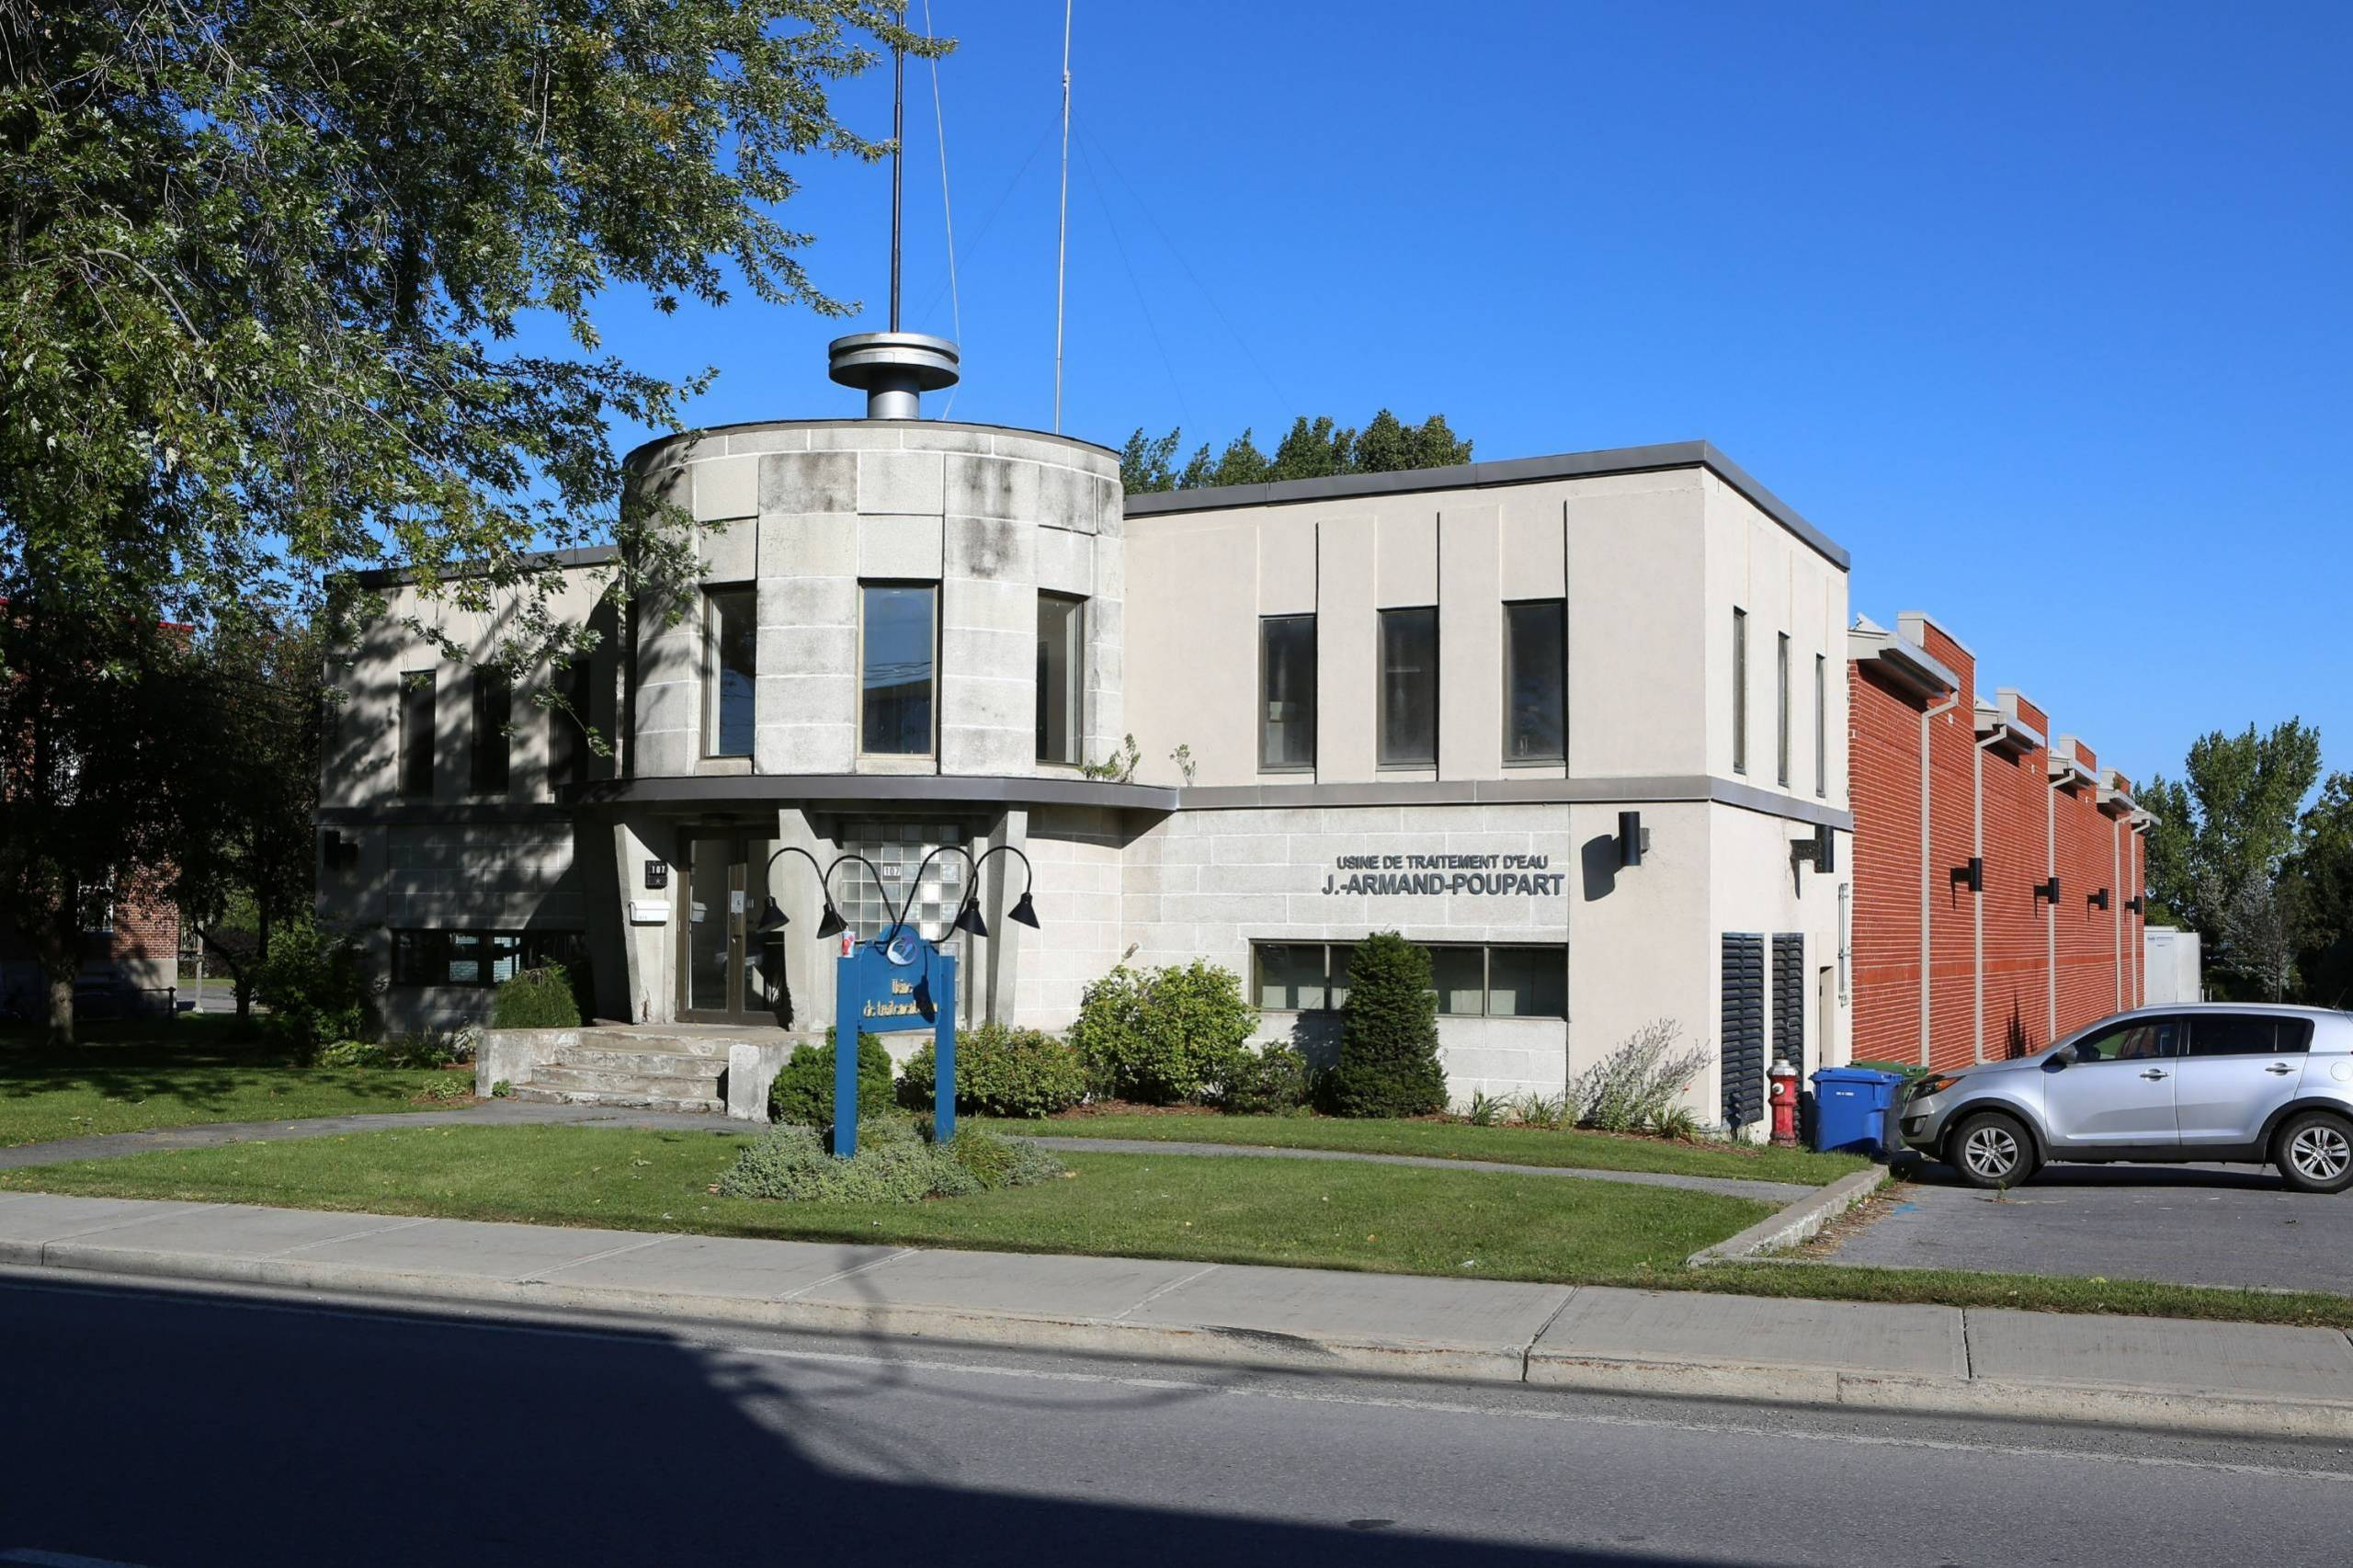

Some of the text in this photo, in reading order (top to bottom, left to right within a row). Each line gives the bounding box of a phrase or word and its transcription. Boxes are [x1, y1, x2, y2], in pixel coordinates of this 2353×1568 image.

[1336, 855, 1548, 869] USINE DE TRAITEMENT D'EAU
[652, 865, 665, 874] 107
[884, 866, 900, 876] 107
[1322, 873, 1564, 895] J.-ARMAND-POUPART
